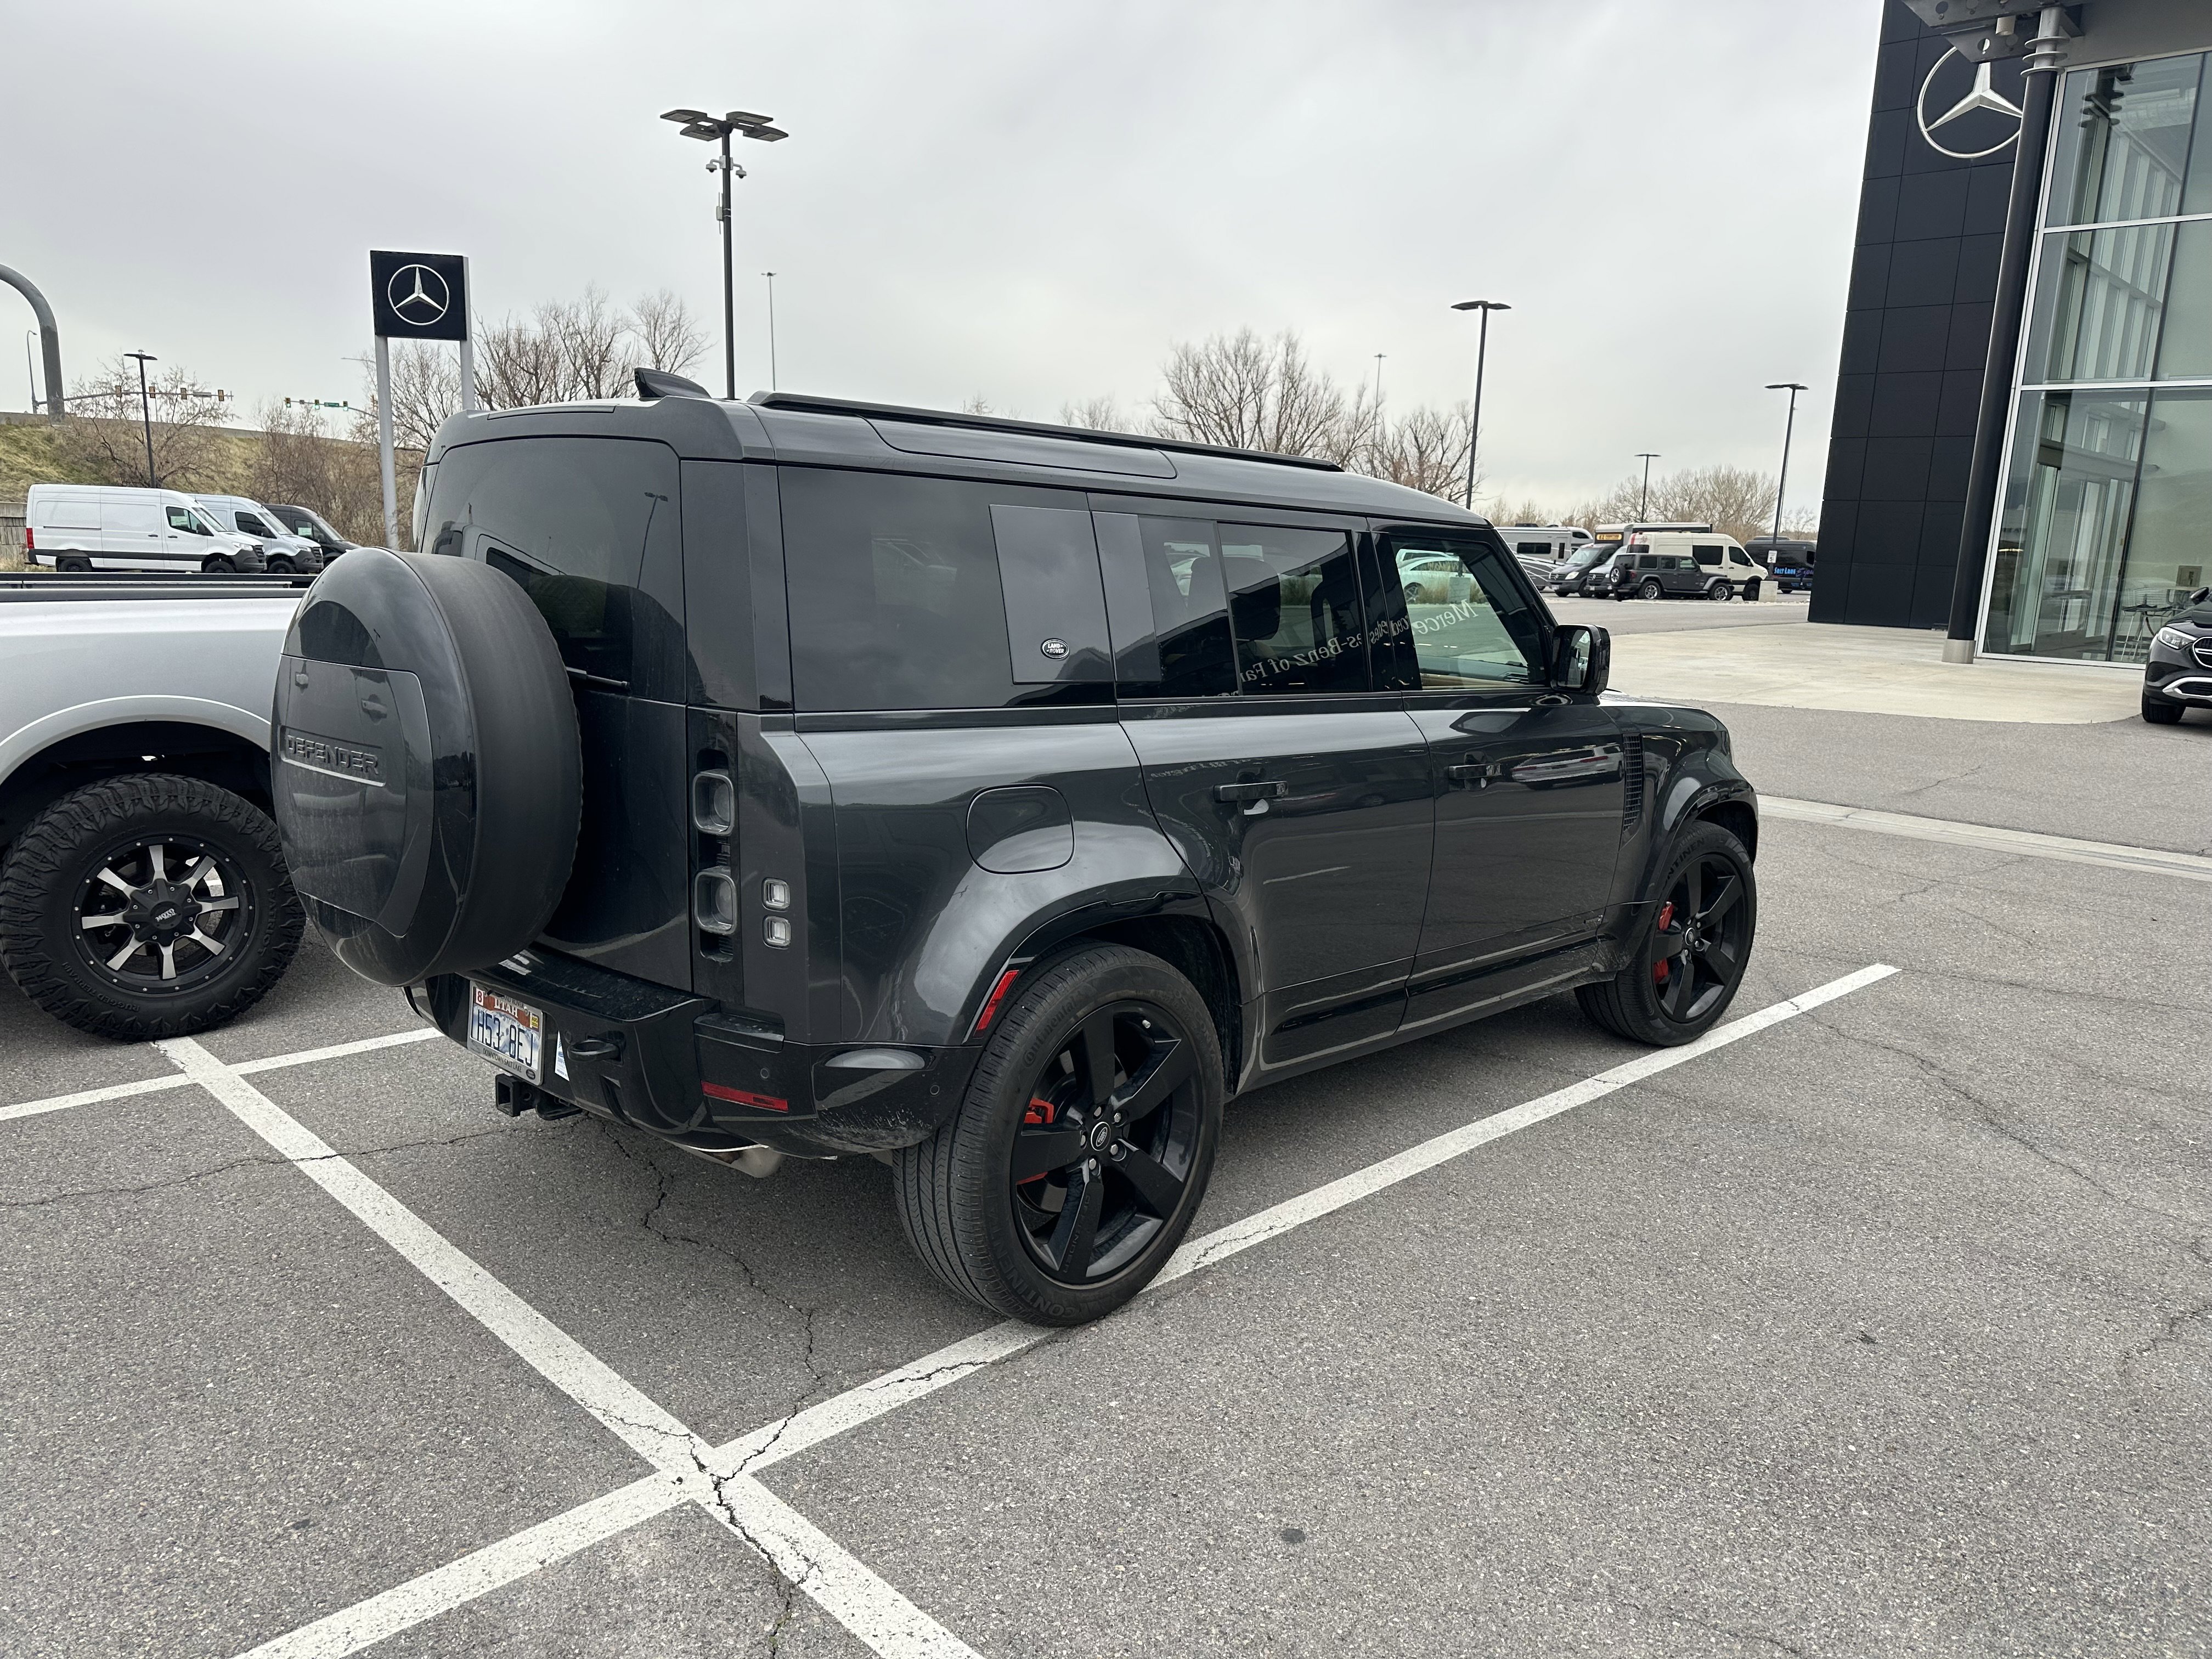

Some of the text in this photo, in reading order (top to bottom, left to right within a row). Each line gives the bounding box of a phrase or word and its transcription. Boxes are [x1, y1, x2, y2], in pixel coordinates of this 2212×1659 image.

[286, 734, 379, 775] DEFENDER
[155, 908, 175, 922] MOTO
[257, 887, 277, 957] PATRIOT
[60, 961, 141, 1013] RUGGED TERRAIN
[477, 990, 482, 1003] 8
[494, 997, 519, 1018] UTAH
[477, 1008, 501, 1050] H53
[509, 1024, 533, 1068] 8EJ
[1022, 996, 1077, 1068] Continental
[483, 1047, 522, 1073] DOWNTOWN SALT LAKE
